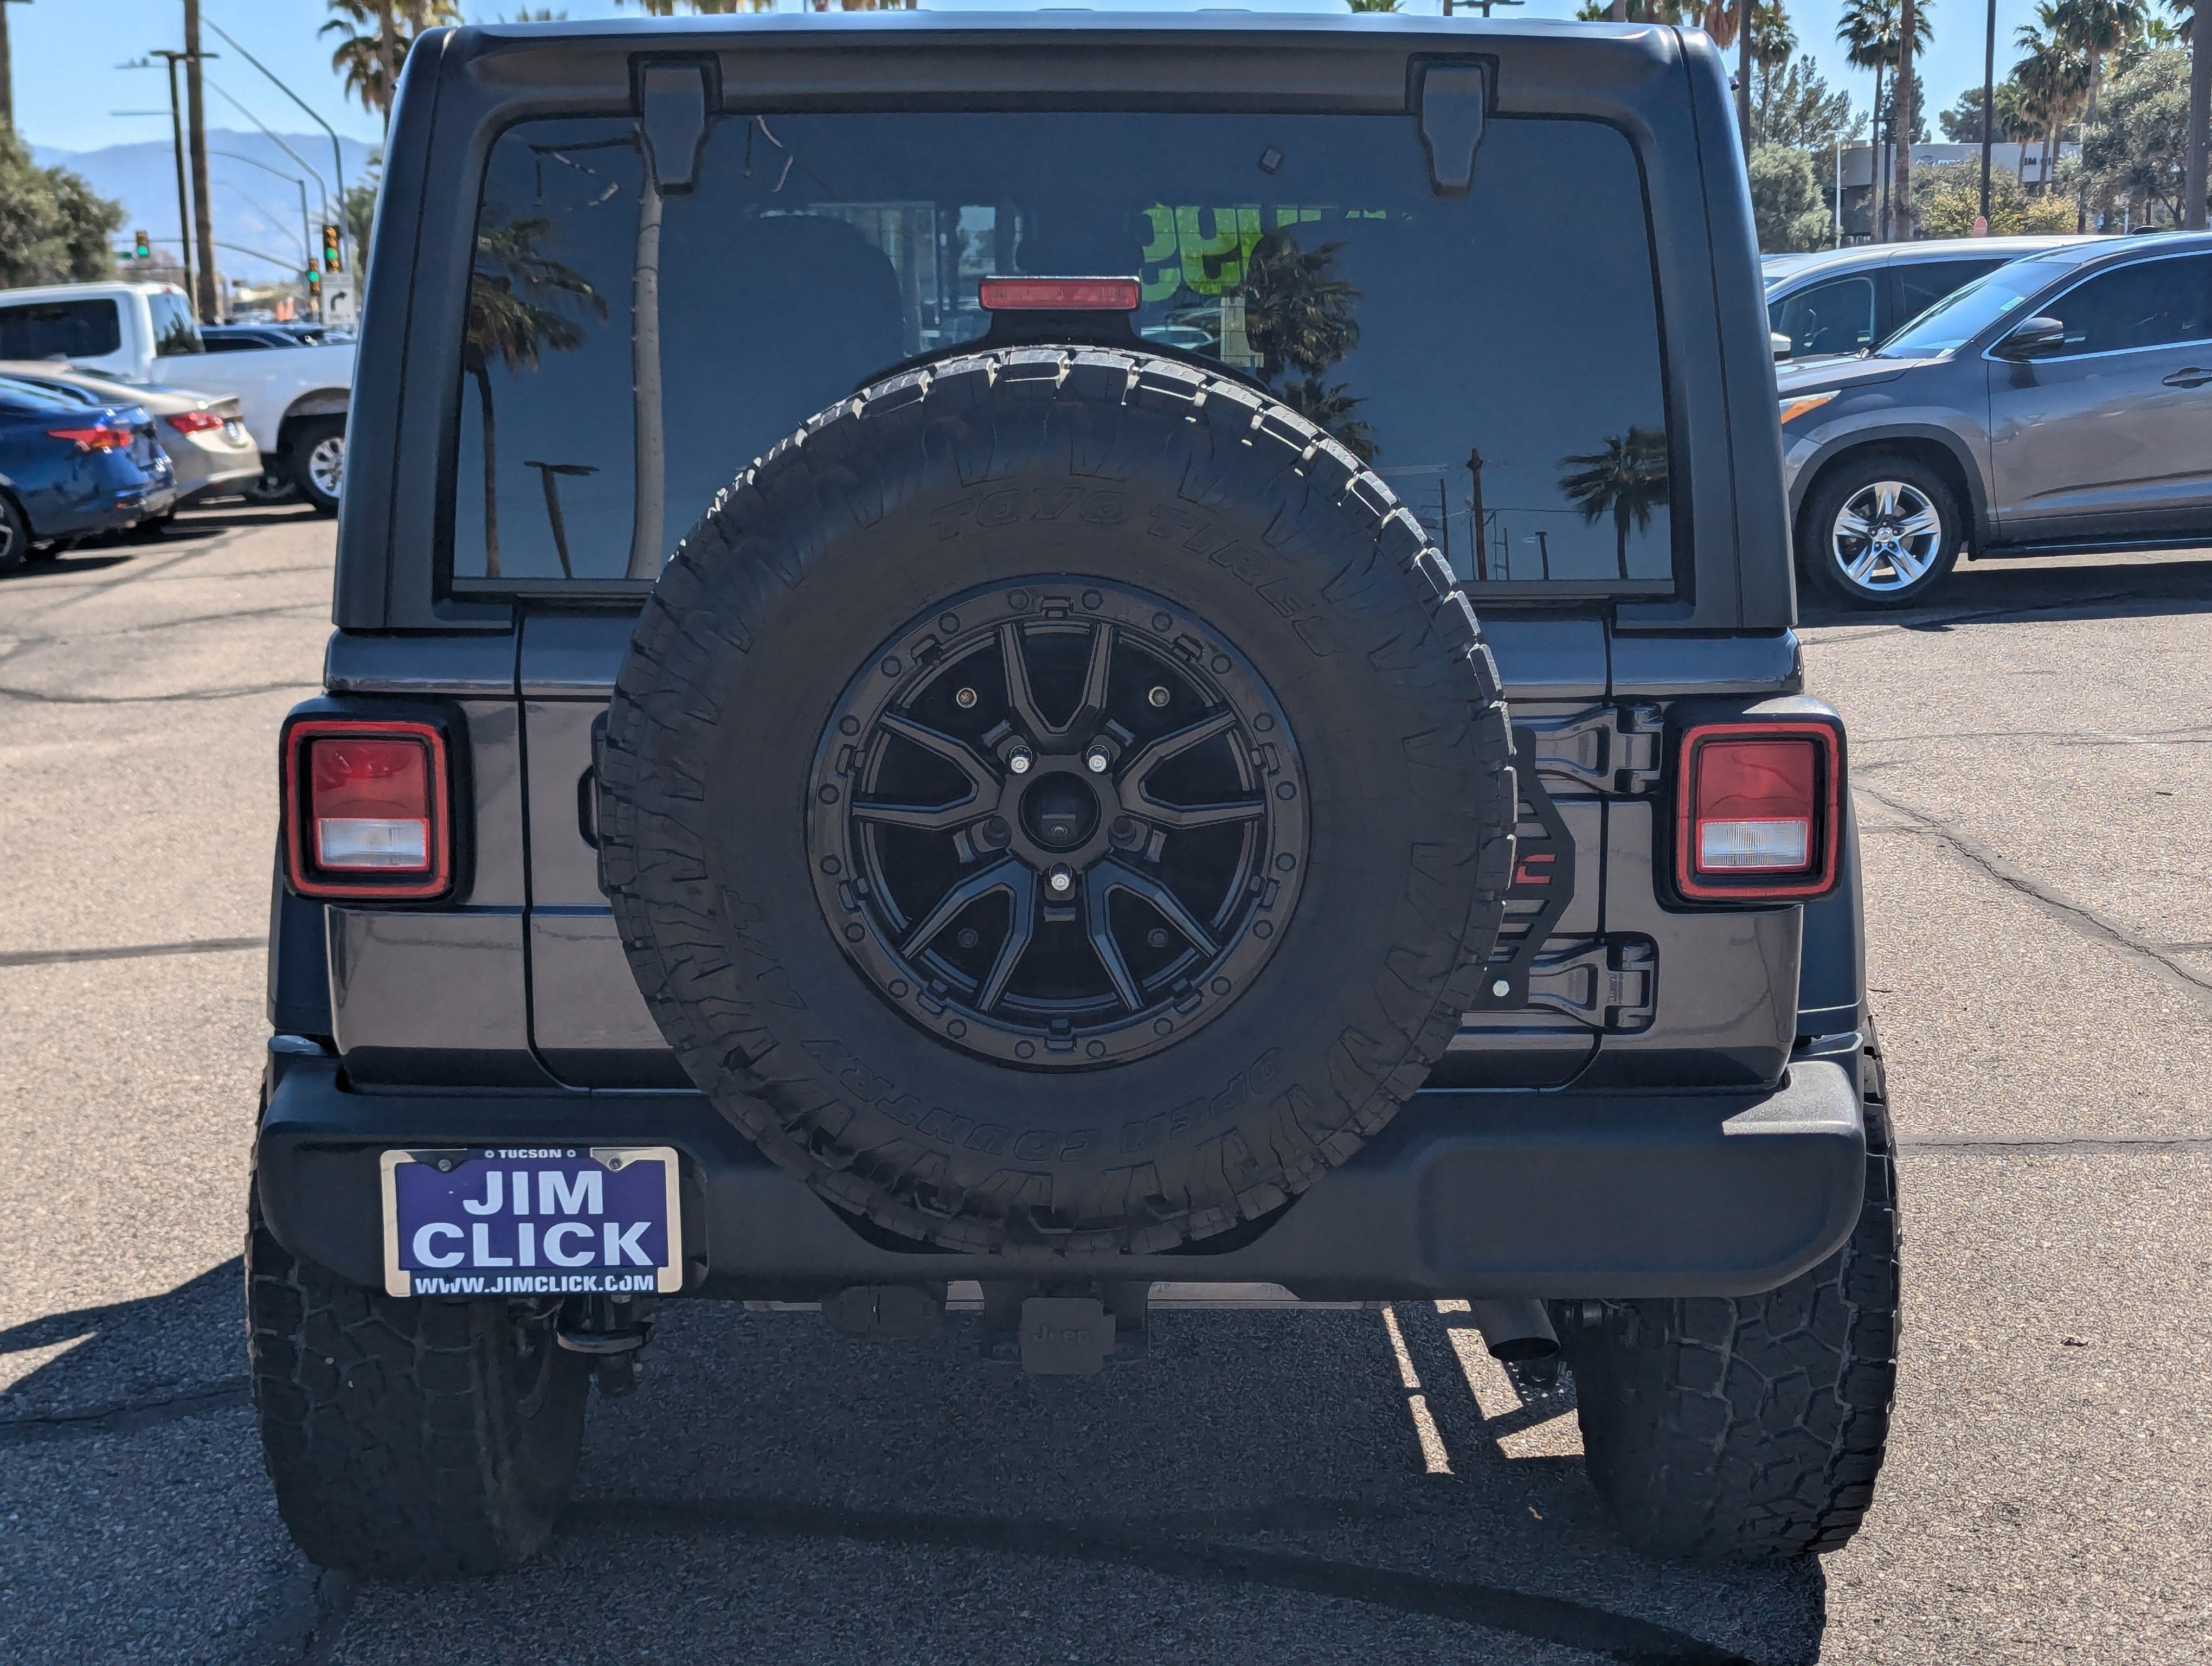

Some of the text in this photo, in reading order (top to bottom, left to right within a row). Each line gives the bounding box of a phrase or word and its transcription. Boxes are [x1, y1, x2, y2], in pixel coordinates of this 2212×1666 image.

[929, 486, 1343, 657] TOYO TIRES
[801, 1040, 1099, 1161] COUNTRY
[1121, 1047, 1282, 1152] OPEN
[498, 1149, 562, 1158] TUCSON
[462, 1170, 603, 1215] JIM
[413, 1222, 654, 1267] CLICK
[415, 1275, 654, 1293] WWW.JIMCLICK.COM
